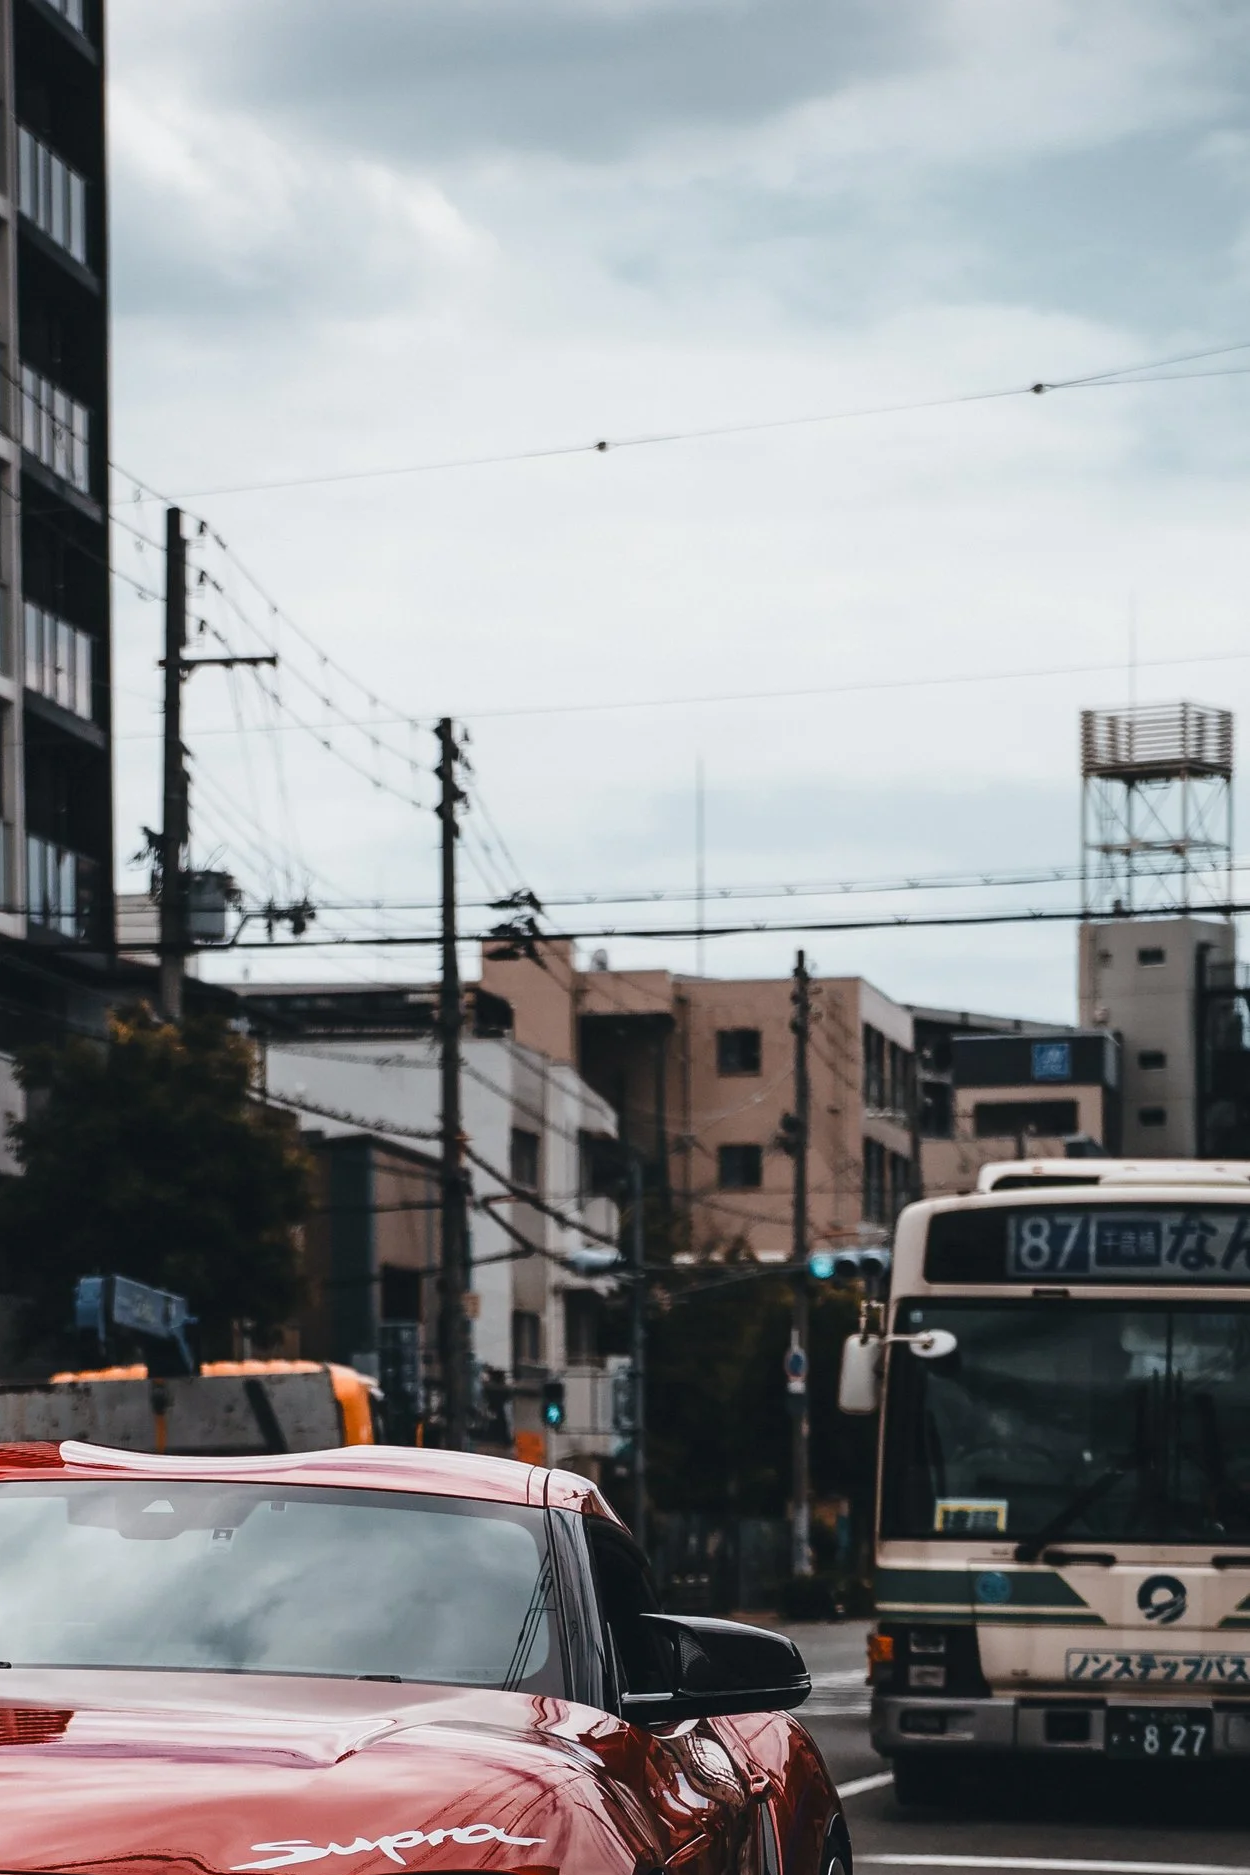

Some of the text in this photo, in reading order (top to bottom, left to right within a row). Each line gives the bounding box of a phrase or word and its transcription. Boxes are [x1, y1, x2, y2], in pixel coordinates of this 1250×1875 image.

[1020, 1214, 1084, 1271] 87
[1072, 1653, 1249, 1684] ノンステップバス
[229, 1822, 547, 1871] Supra
